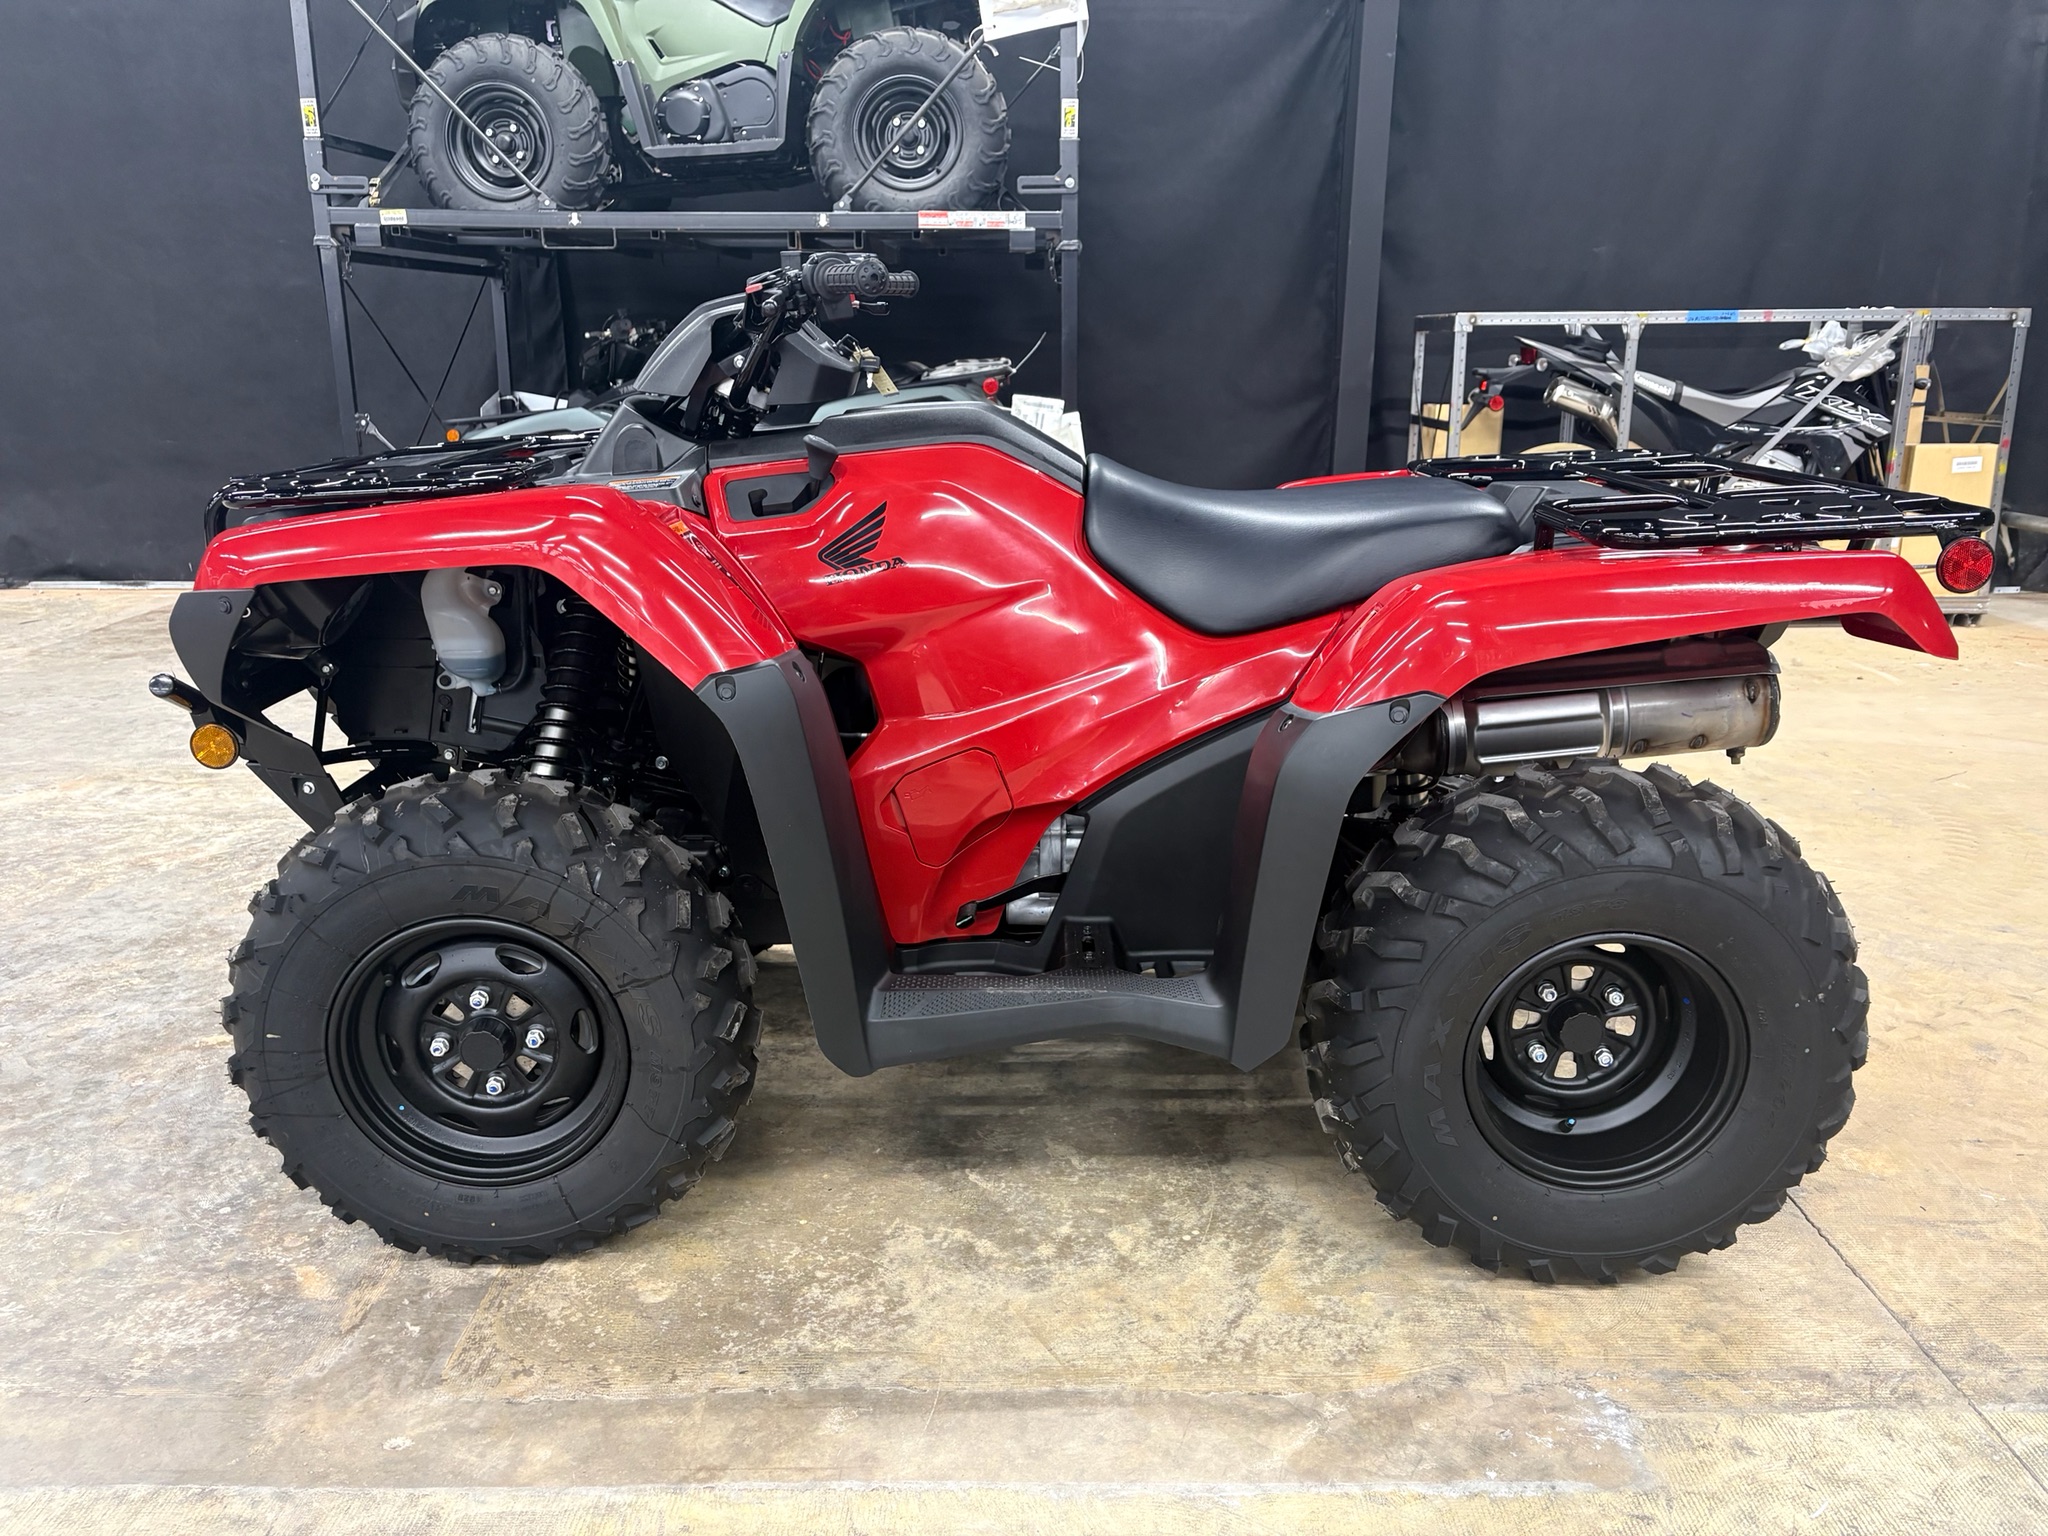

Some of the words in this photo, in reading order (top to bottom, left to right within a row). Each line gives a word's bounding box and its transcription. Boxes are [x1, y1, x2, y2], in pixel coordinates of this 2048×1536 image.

[823, 556, 908, 586] HONDA
[450, 884, 663, 1039] MAXXIS
[1424, 920, 1533, 1148] MAXXIS
